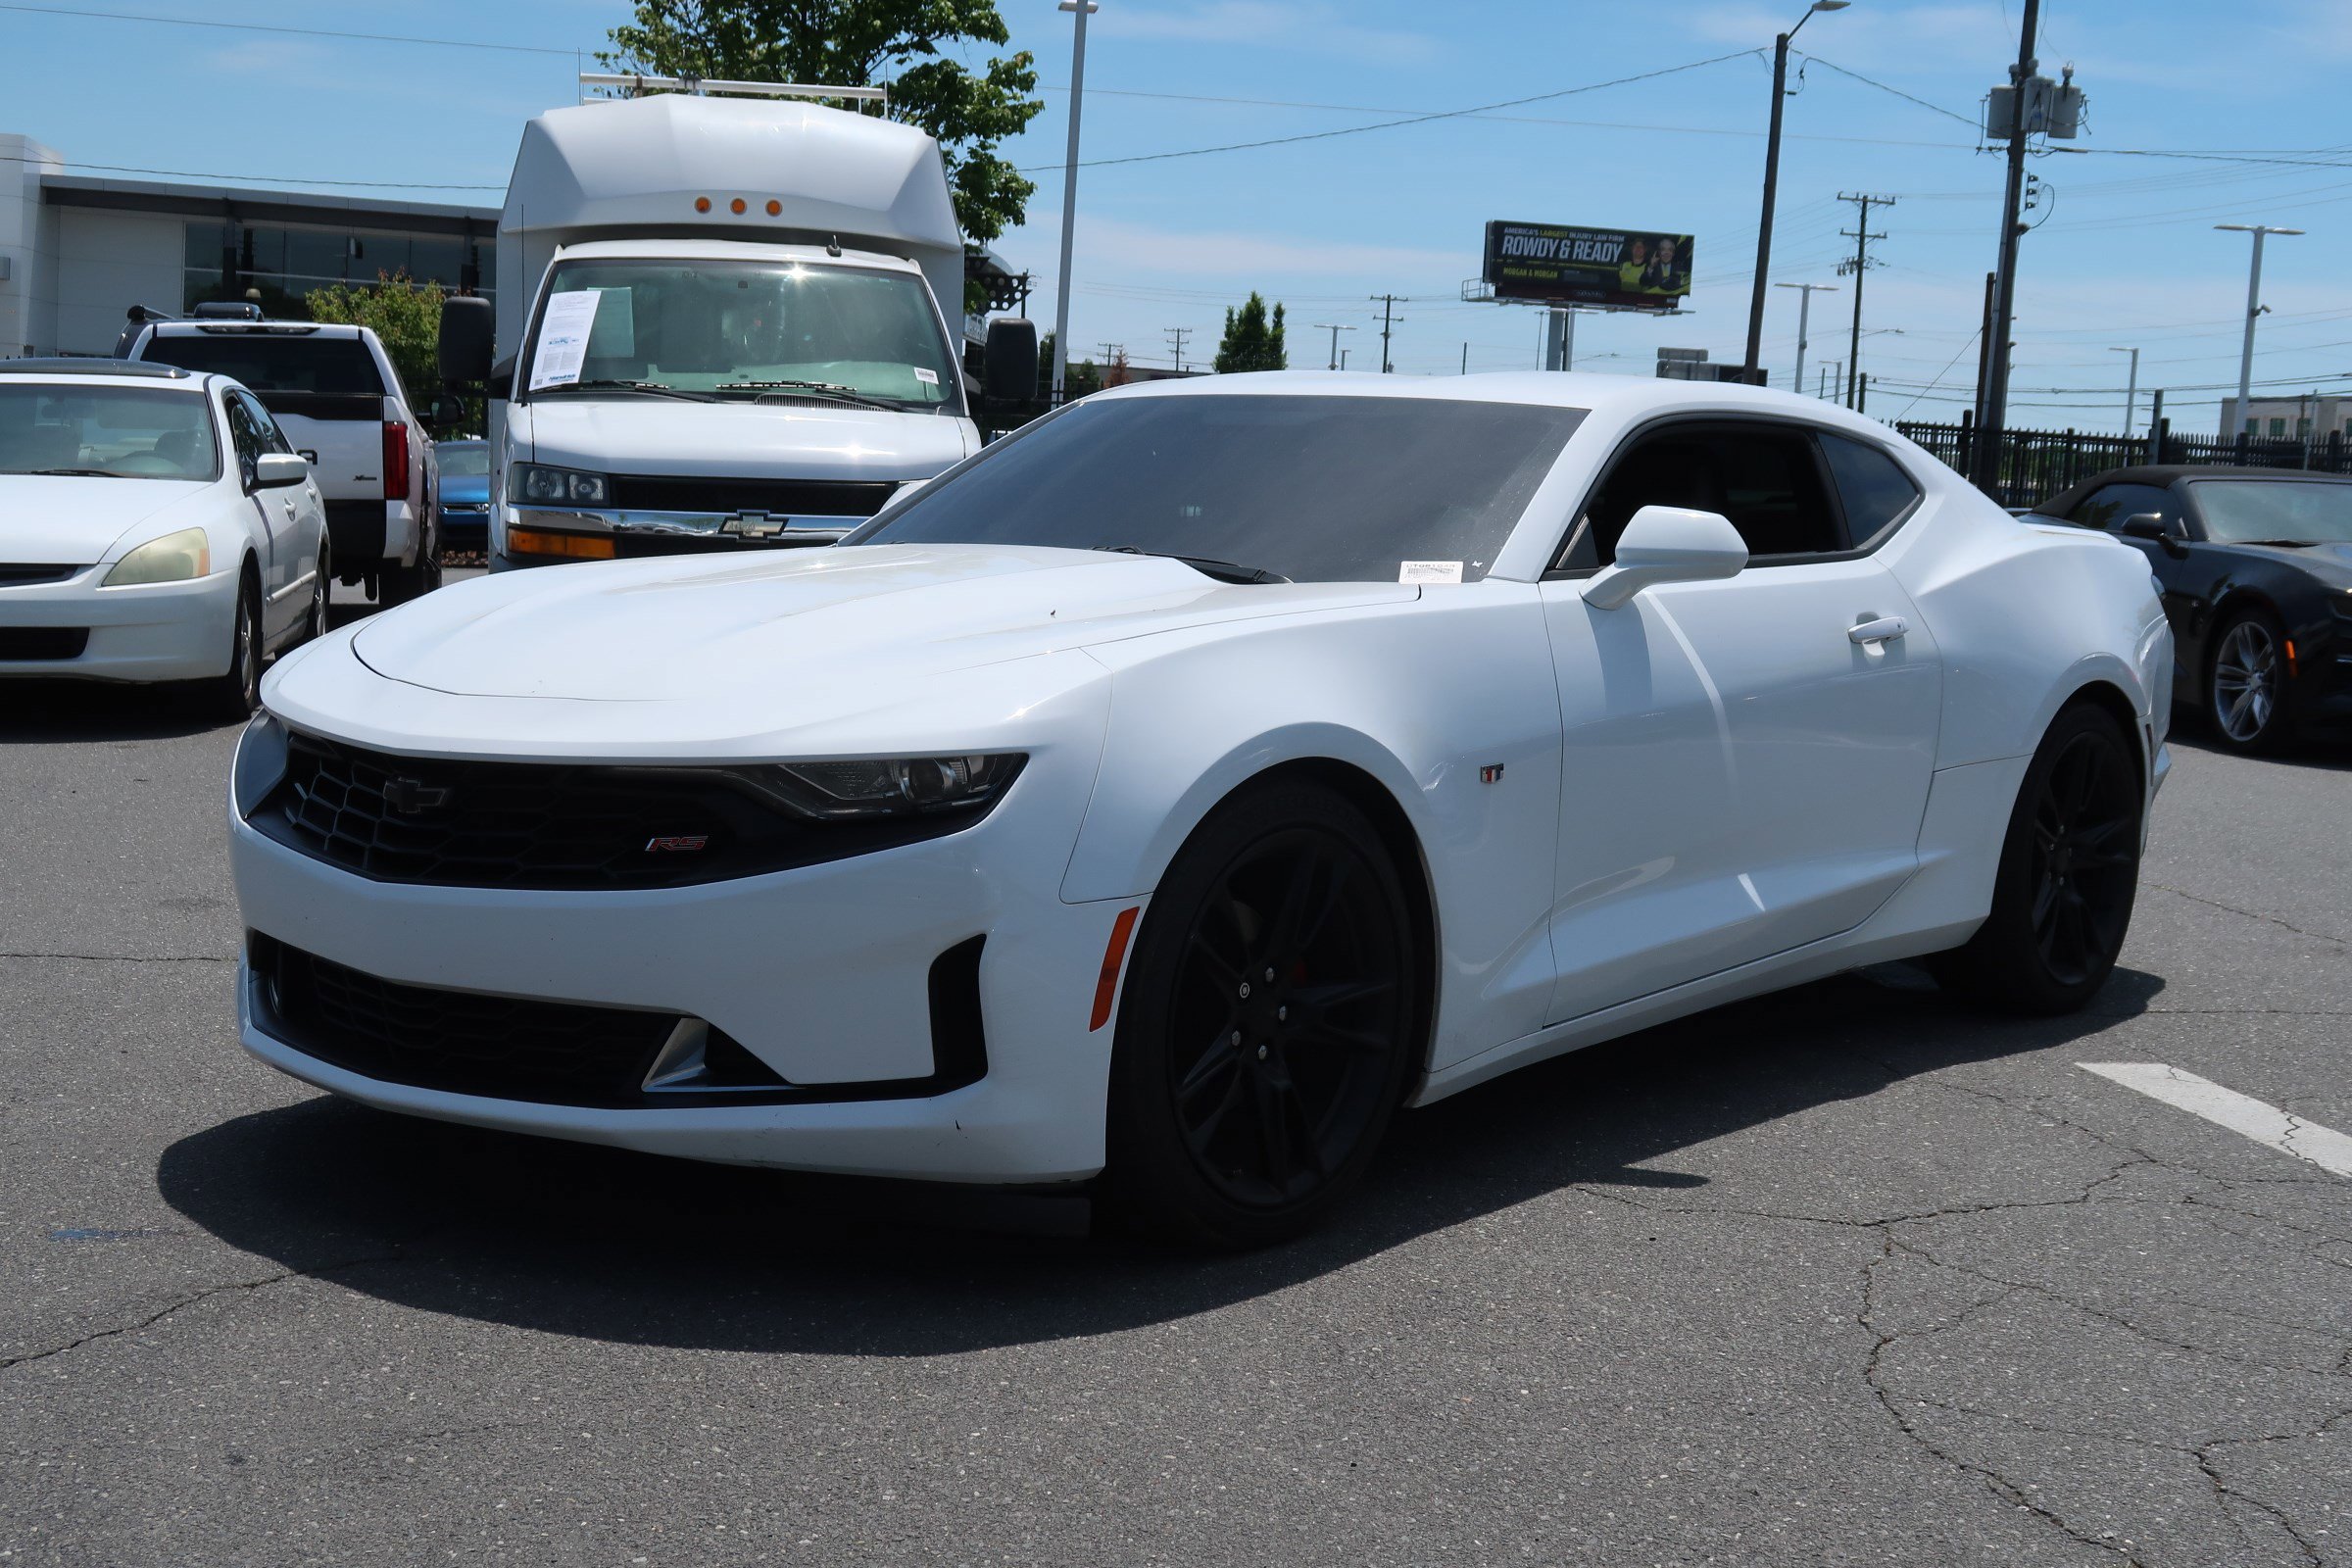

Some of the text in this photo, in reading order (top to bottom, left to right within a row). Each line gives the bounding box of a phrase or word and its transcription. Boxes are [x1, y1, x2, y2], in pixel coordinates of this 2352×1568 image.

[1504, 226, 1539, 235] AMERICA'S
[1501, 235, 1624, 263] ROWDY & READY
[1503, 267, 1528, 276] MORGAN
[1534, 270, 1558, 278] MORGAN
[645, 836, 709, 851] RS
